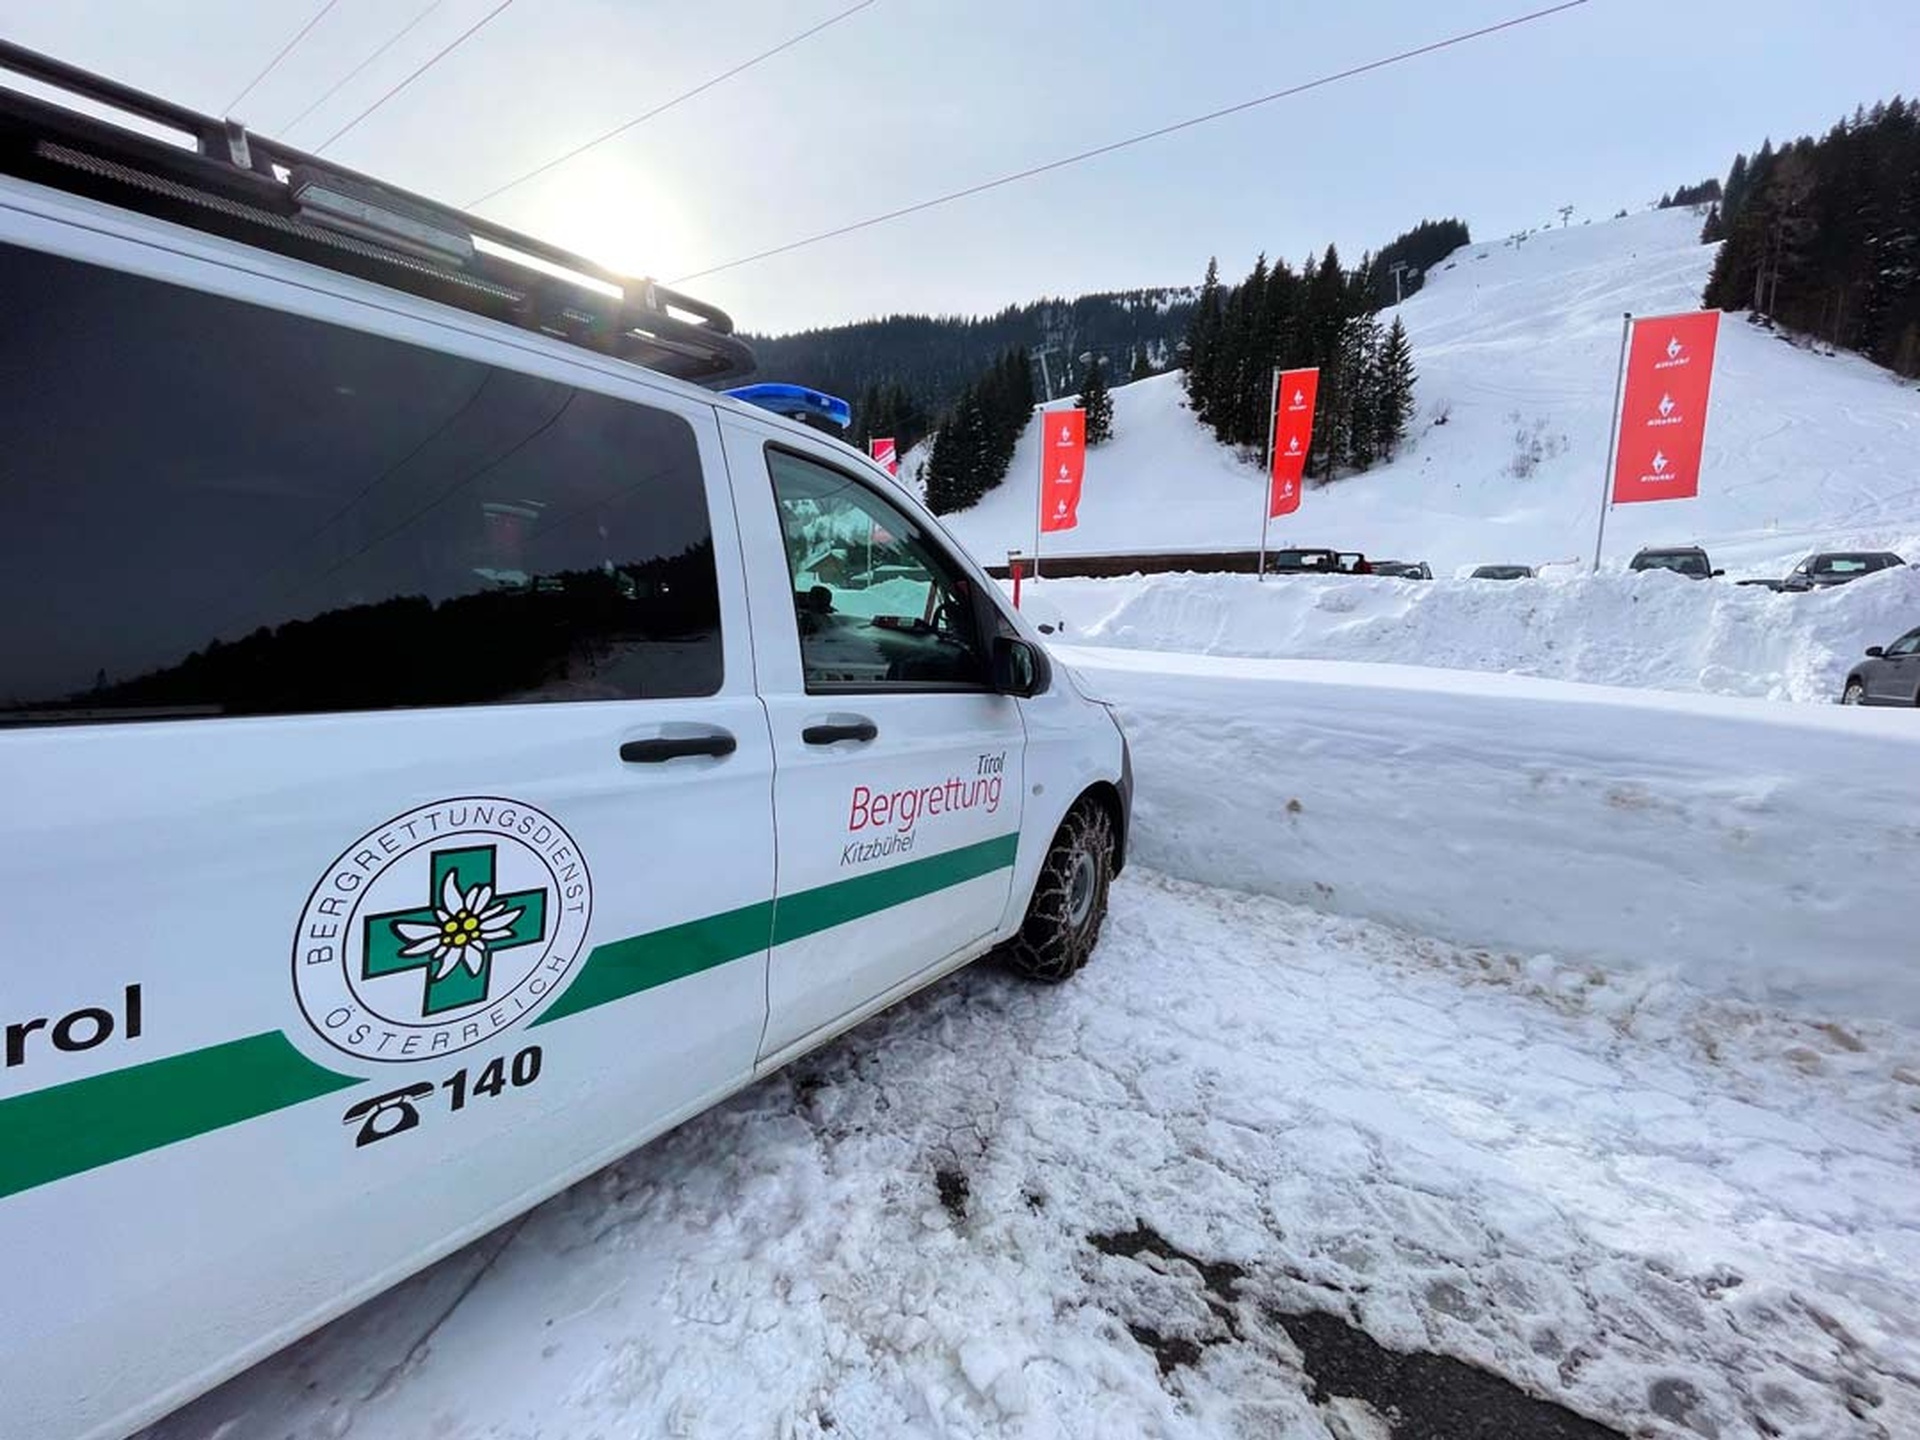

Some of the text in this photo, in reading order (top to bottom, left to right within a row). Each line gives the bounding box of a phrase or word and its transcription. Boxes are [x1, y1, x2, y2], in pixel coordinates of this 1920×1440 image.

[977, 751, 1006, 774] Tirol
[849, 777, 1001, 832] Bergrettung
[840, 831, 916, 866] Kitzbühel
[307, 806, 586, 965] BERGRETTUNGSDIENST
[6, 983, 142, 1067] rol
[325, 954, 567, 1055] ÖSTERREICH
[442, 1045, 543, 1111] 140
